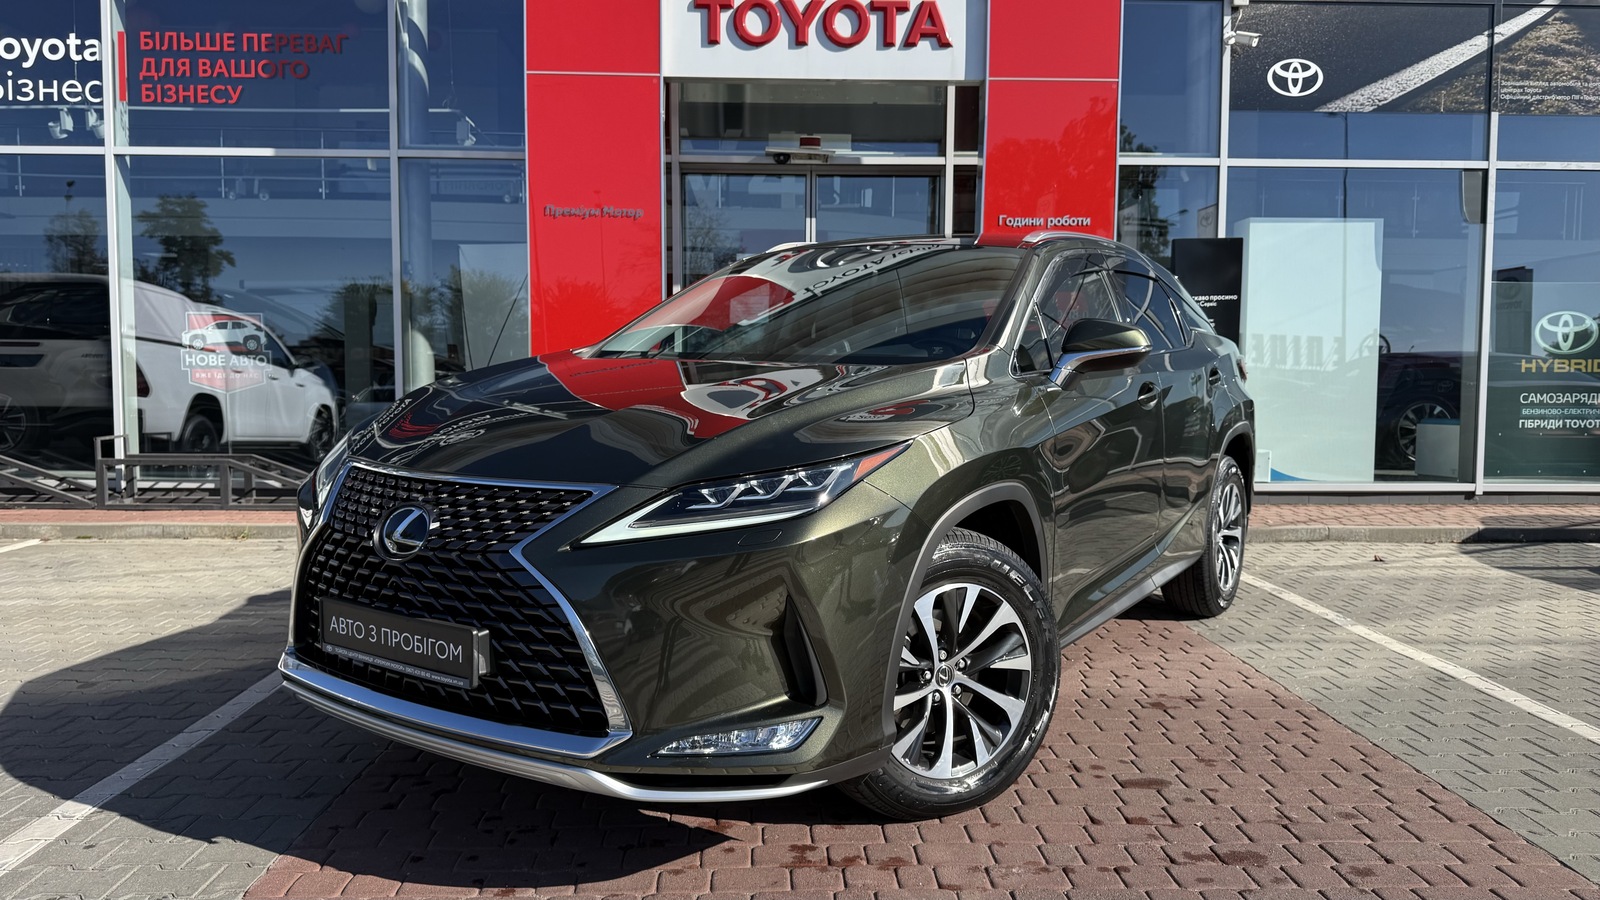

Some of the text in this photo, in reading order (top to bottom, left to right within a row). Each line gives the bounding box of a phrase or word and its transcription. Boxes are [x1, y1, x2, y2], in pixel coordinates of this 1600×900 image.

[694, 0, 953, 47] TOYOTA
[0, 32, 102, 68] oyota
[139, 31, 349, 54] БІЛЬШЕ ПЕРЕВАГ
[139, 57, 310, 81] ДЛЯ ВАШОГО
[0, 70, 103, 103] ізнес
[141, 84, 243, 104] БІЗНЕСУ
[544, 204, 644, 220] Преміум Мотор
[998, 214, 1091, 229] Години роботи
[185, 354, 267, 367] НОВЕ АВТО
[1520, 392, 1600, 405] САМОЗАРЯД
[1519, 419, 1563, 430] ГІБРИДИ
[329, 615, 365, 639] АВТО
[381, 628, 463, 664] ПРОБІГОМ
